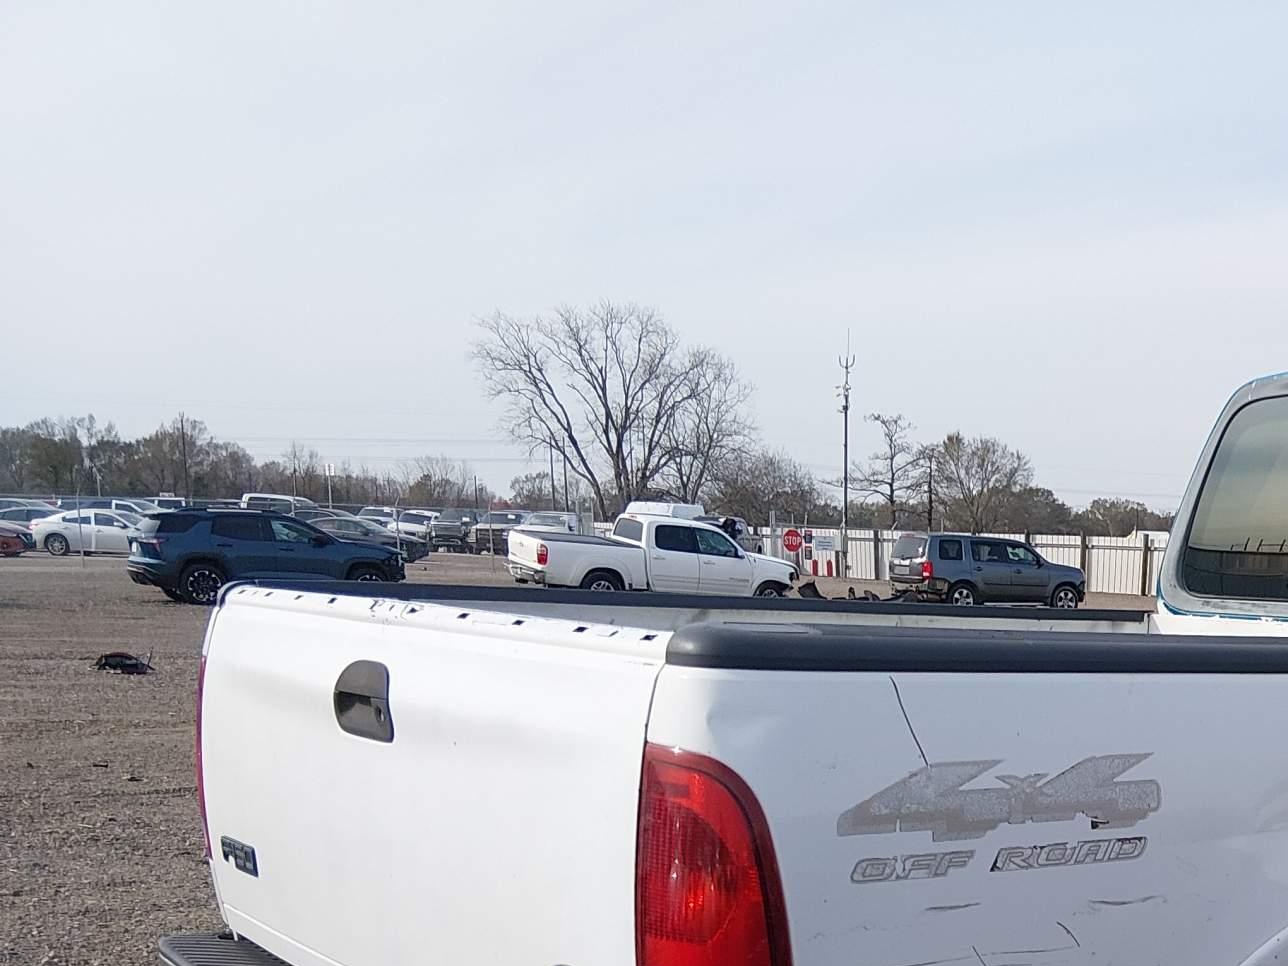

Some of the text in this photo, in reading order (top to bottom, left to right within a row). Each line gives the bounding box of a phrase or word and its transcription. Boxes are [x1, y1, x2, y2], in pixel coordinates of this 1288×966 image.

[784, 536, 801, 545] STOP
[850, 836, 1149, 884] OFF ROAD
